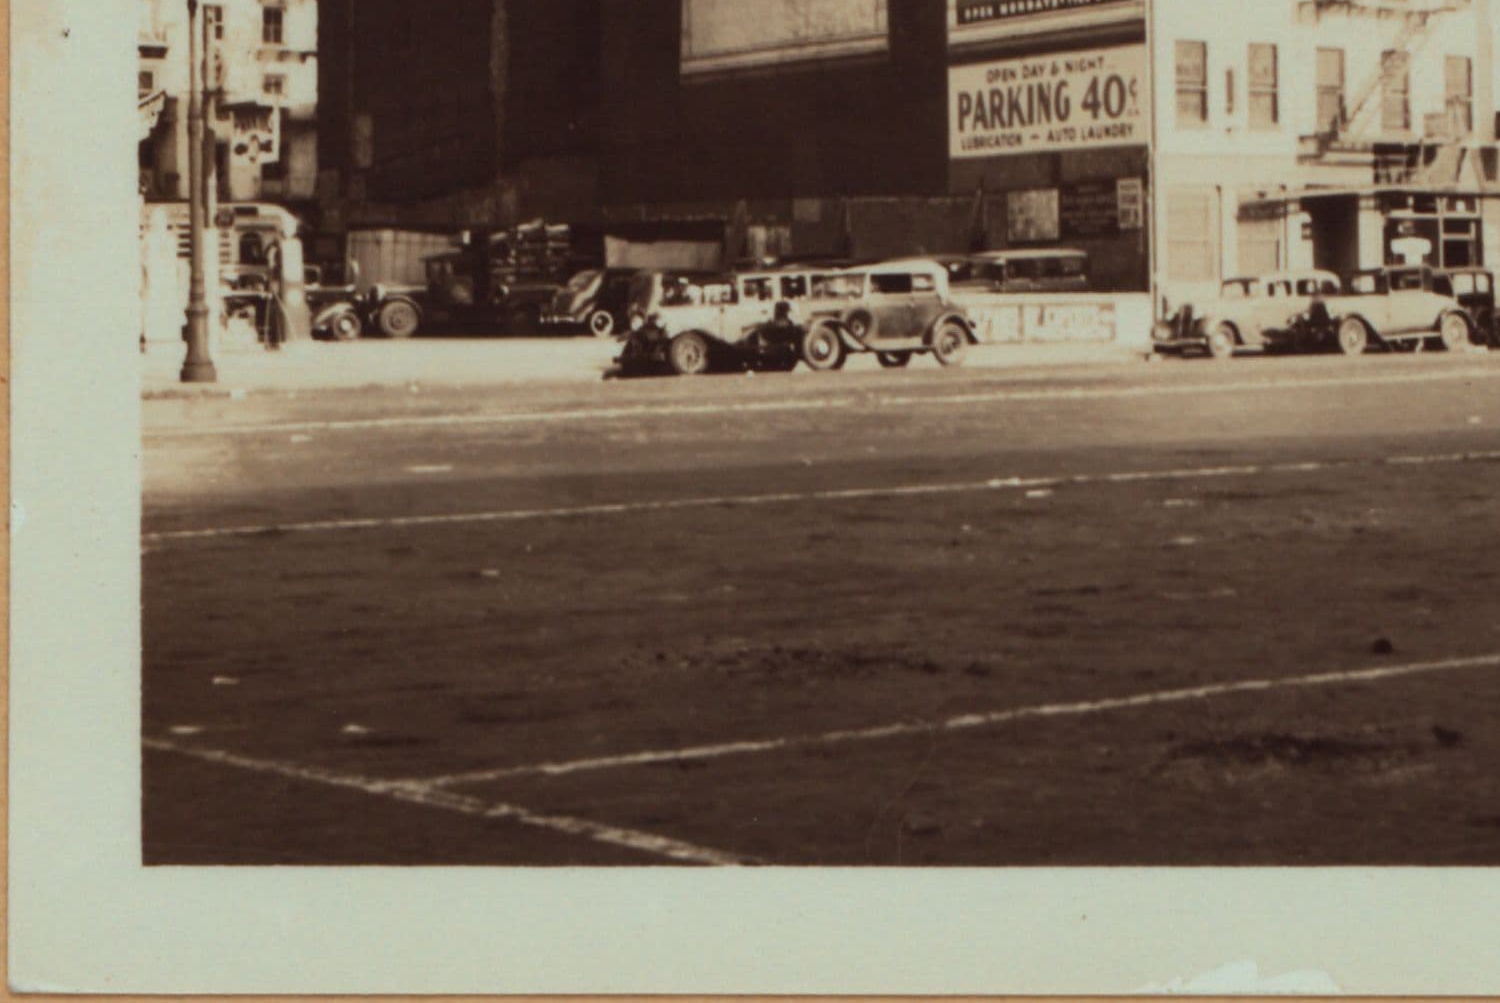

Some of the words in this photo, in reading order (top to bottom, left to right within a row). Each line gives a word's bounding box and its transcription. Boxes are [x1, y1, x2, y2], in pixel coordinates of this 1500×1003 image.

[986, 68, 1017, 84] OPEN
[1022, 62, 1045, 79] DAY
[1051, 62, 1060, 76] &
[1065, 55, 1104, 73] NIGHT
[958, 80, 1071, 132] PARKING
[961, 132, 1022, 150] LUBRICATION
[1046, 127, 1076, 143] AUTO
[1081, 123, 1134, 141] LAUNDRY
